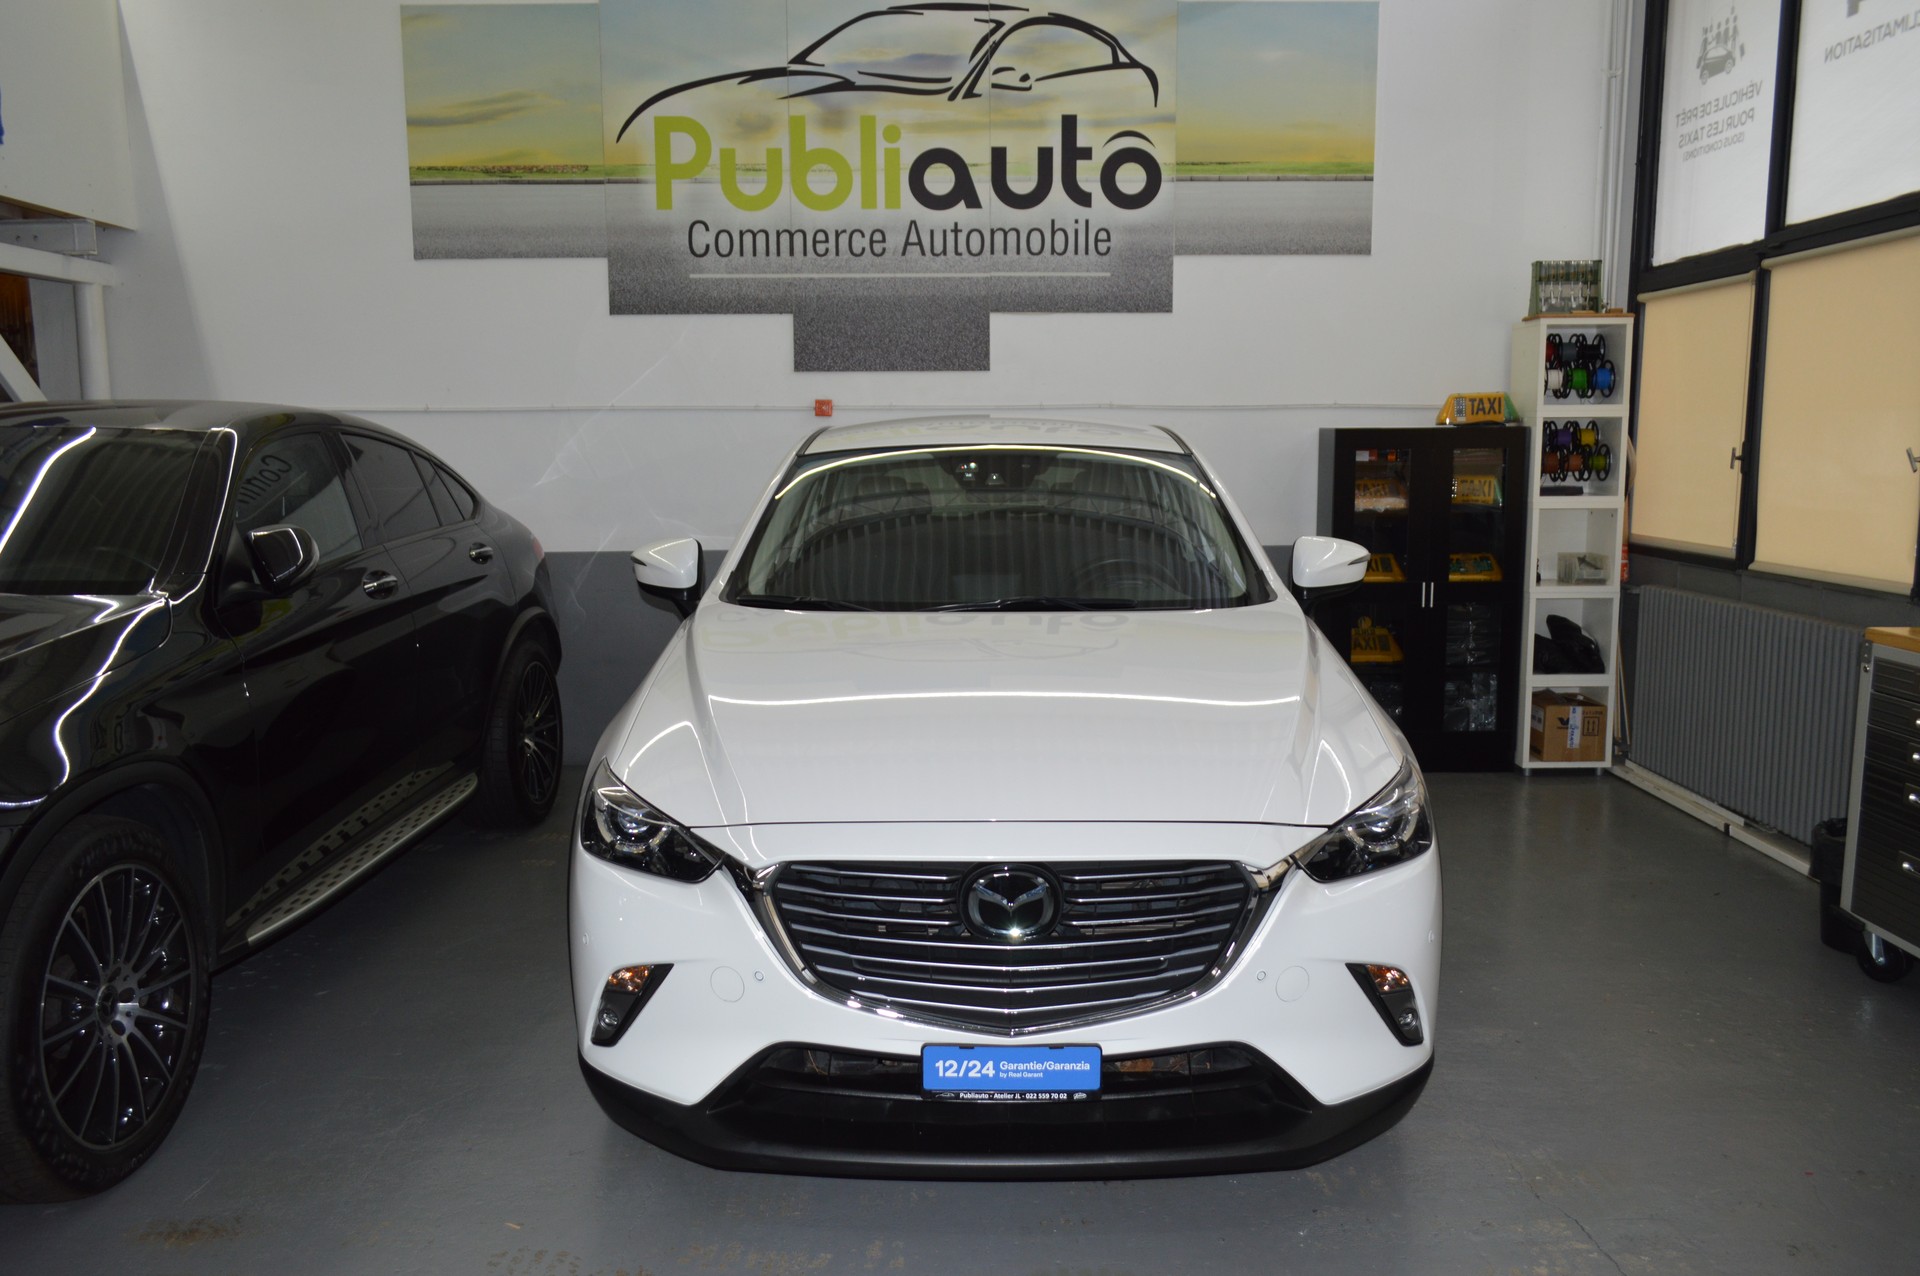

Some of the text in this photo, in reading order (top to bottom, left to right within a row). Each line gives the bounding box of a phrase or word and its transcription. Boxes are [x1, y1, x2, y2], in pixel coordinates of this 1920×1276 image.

[688, 219, 1111, 258] Commerce Automobile
[1468, 396, 1503, 416] TAXI
[1352, 633, 1377, 651] AXI
[935, 1059, 1090, 1078] 12/24 Garantie/Garanzia
[999, 1071, 1007, 1079] by
[959, 1092, 989, 1100] Publiauto
[993, 1092, 1014, 1100] Atelier
[1025, 1092, 1037, 1100] 022
[1038, 1092, 1050, 1100] 559
[1050, 1092, 1059, 1100] 70
[1059, 1092, 1068, 1100] 02
